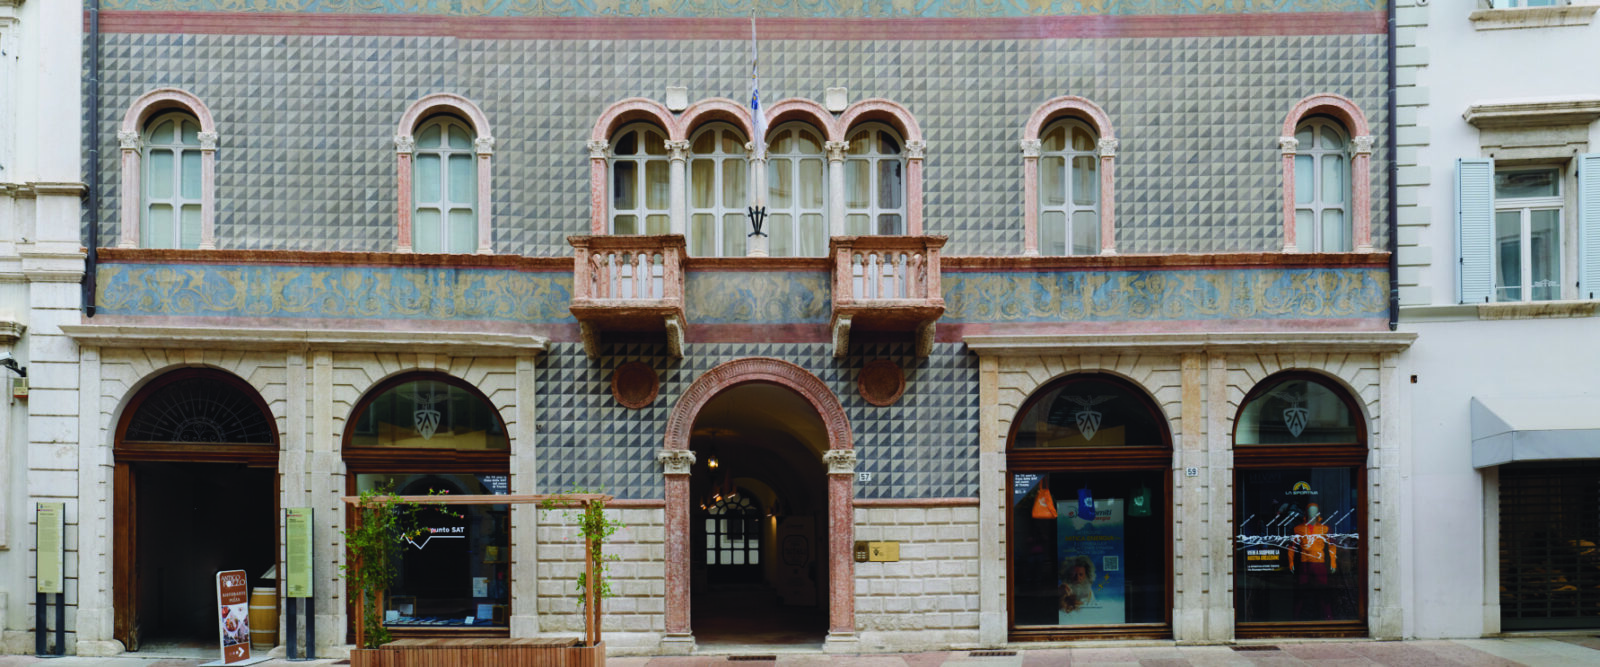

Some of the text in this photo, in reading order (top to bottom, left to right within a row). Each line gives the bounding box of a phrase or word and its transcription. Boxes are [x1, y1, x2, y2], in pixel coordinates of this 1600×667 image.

[415, 411, 440, 432] SAT
[1077, 412, 1100, 433] SAT
[1285, 409, 1308, 430] SAT
